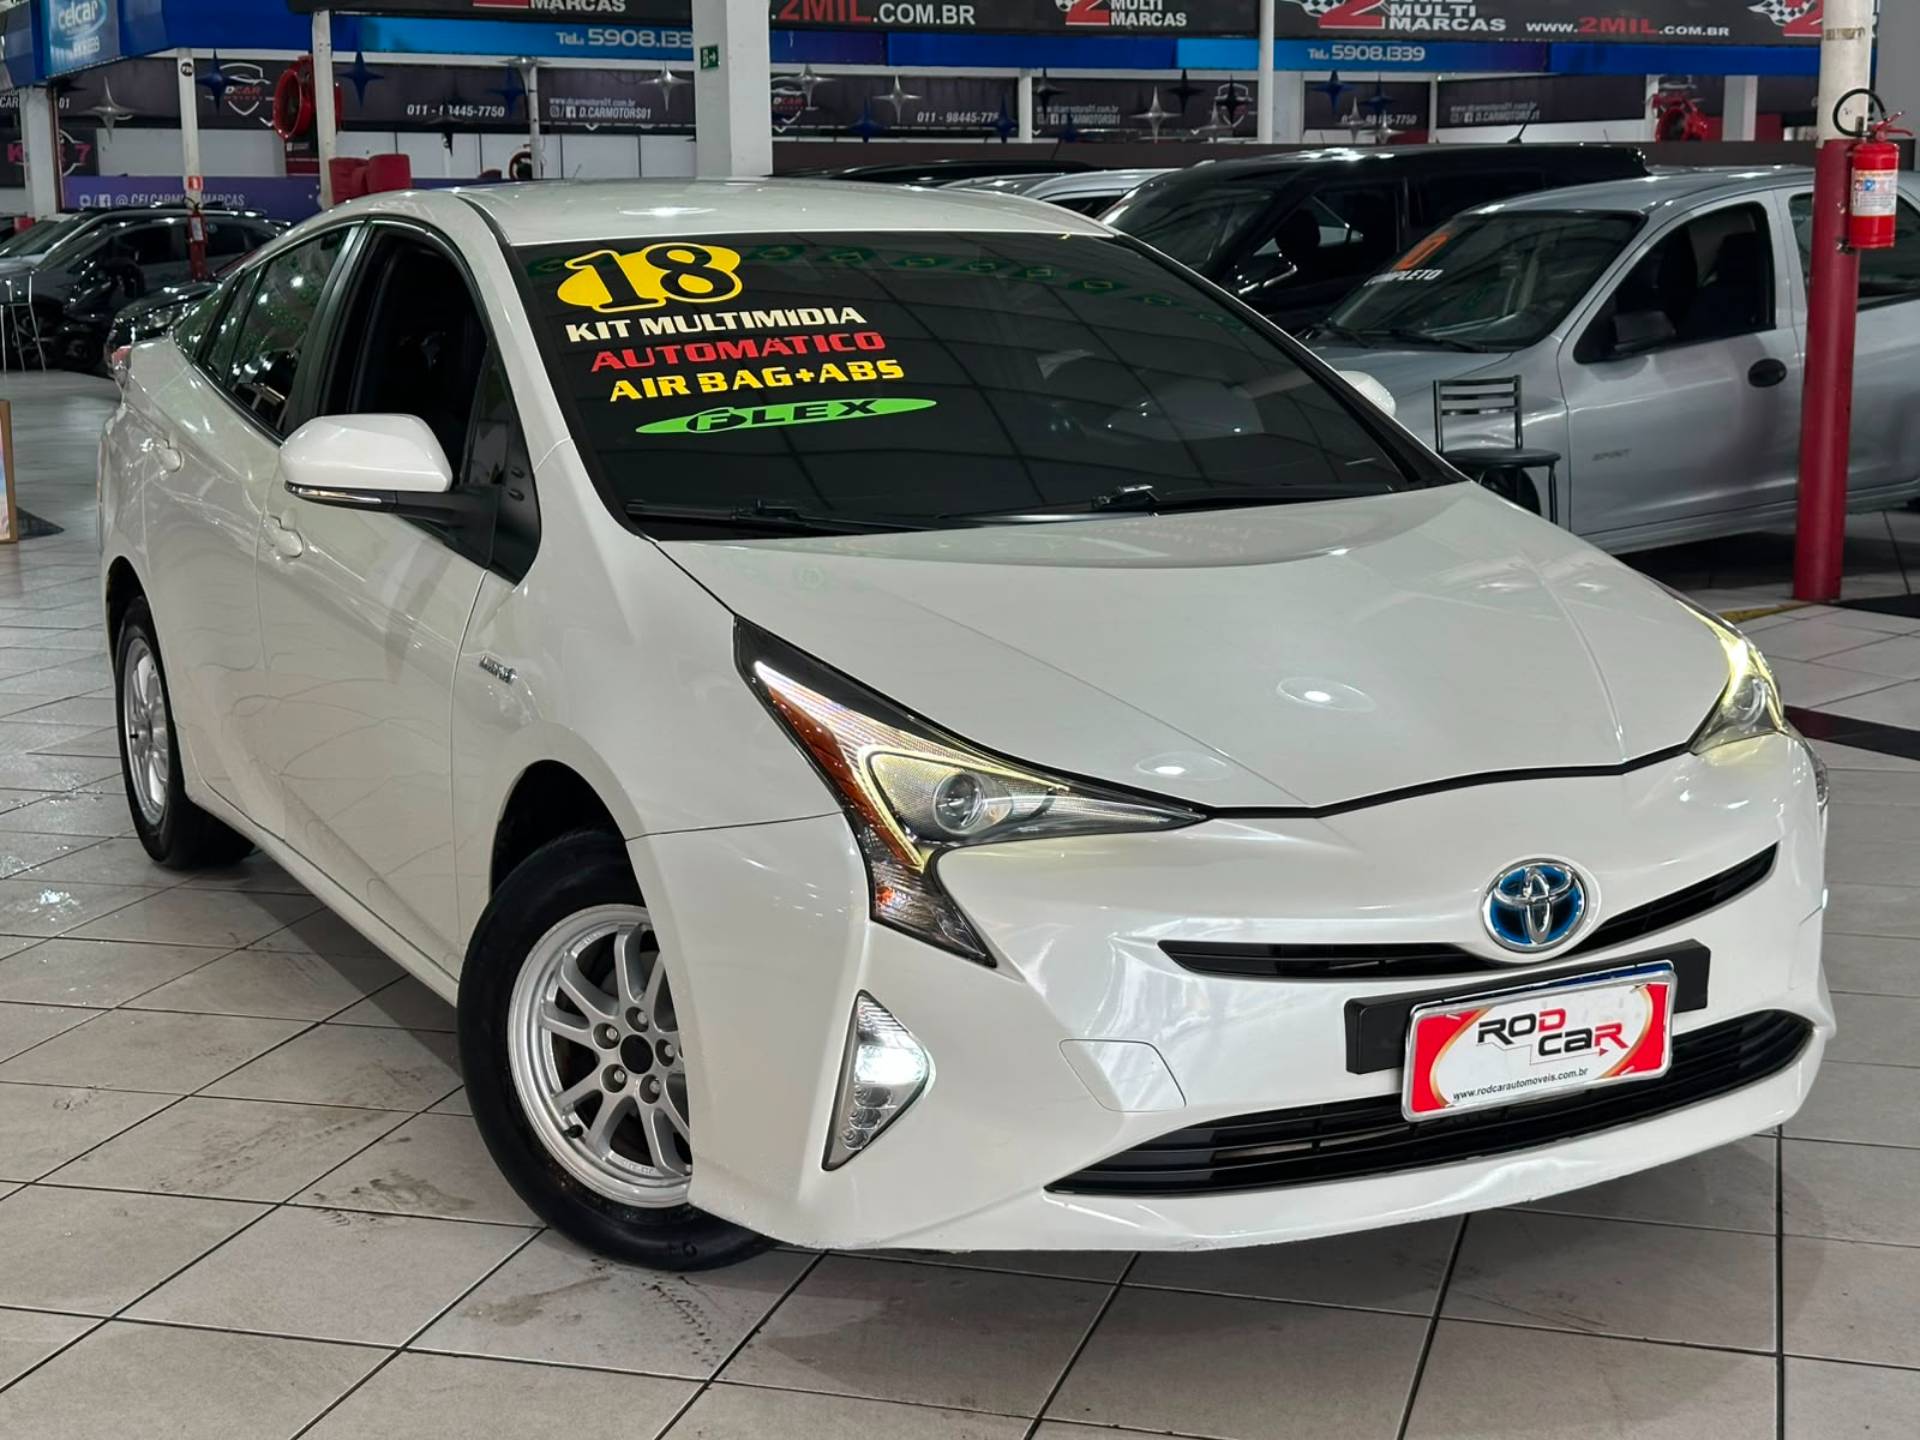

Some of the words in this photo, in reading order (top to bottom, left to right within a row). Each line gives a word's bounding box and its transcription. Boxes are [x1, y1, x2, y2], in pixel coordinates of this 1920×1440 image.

[1110, 12, 1188, 27] MARCAS
[1389, 4, 1476, 18] MULTI
[1389, 17, 1507, 31] MARCAS
[1331, 44, 1426, 62] 5908.1339
[564, 241, 743, 313] 18
[565, 319, 631, 343] KIT
[610, 374, 691, 402] AIR
[696, 359, 905, 394] BAG+ABS
[690, 398, 879, 433] FLEX
[1477, 1007, 1567, 1046] ROD
[1453, 1067, 1589, 1101] www.rodcarautomoveis.com.br
